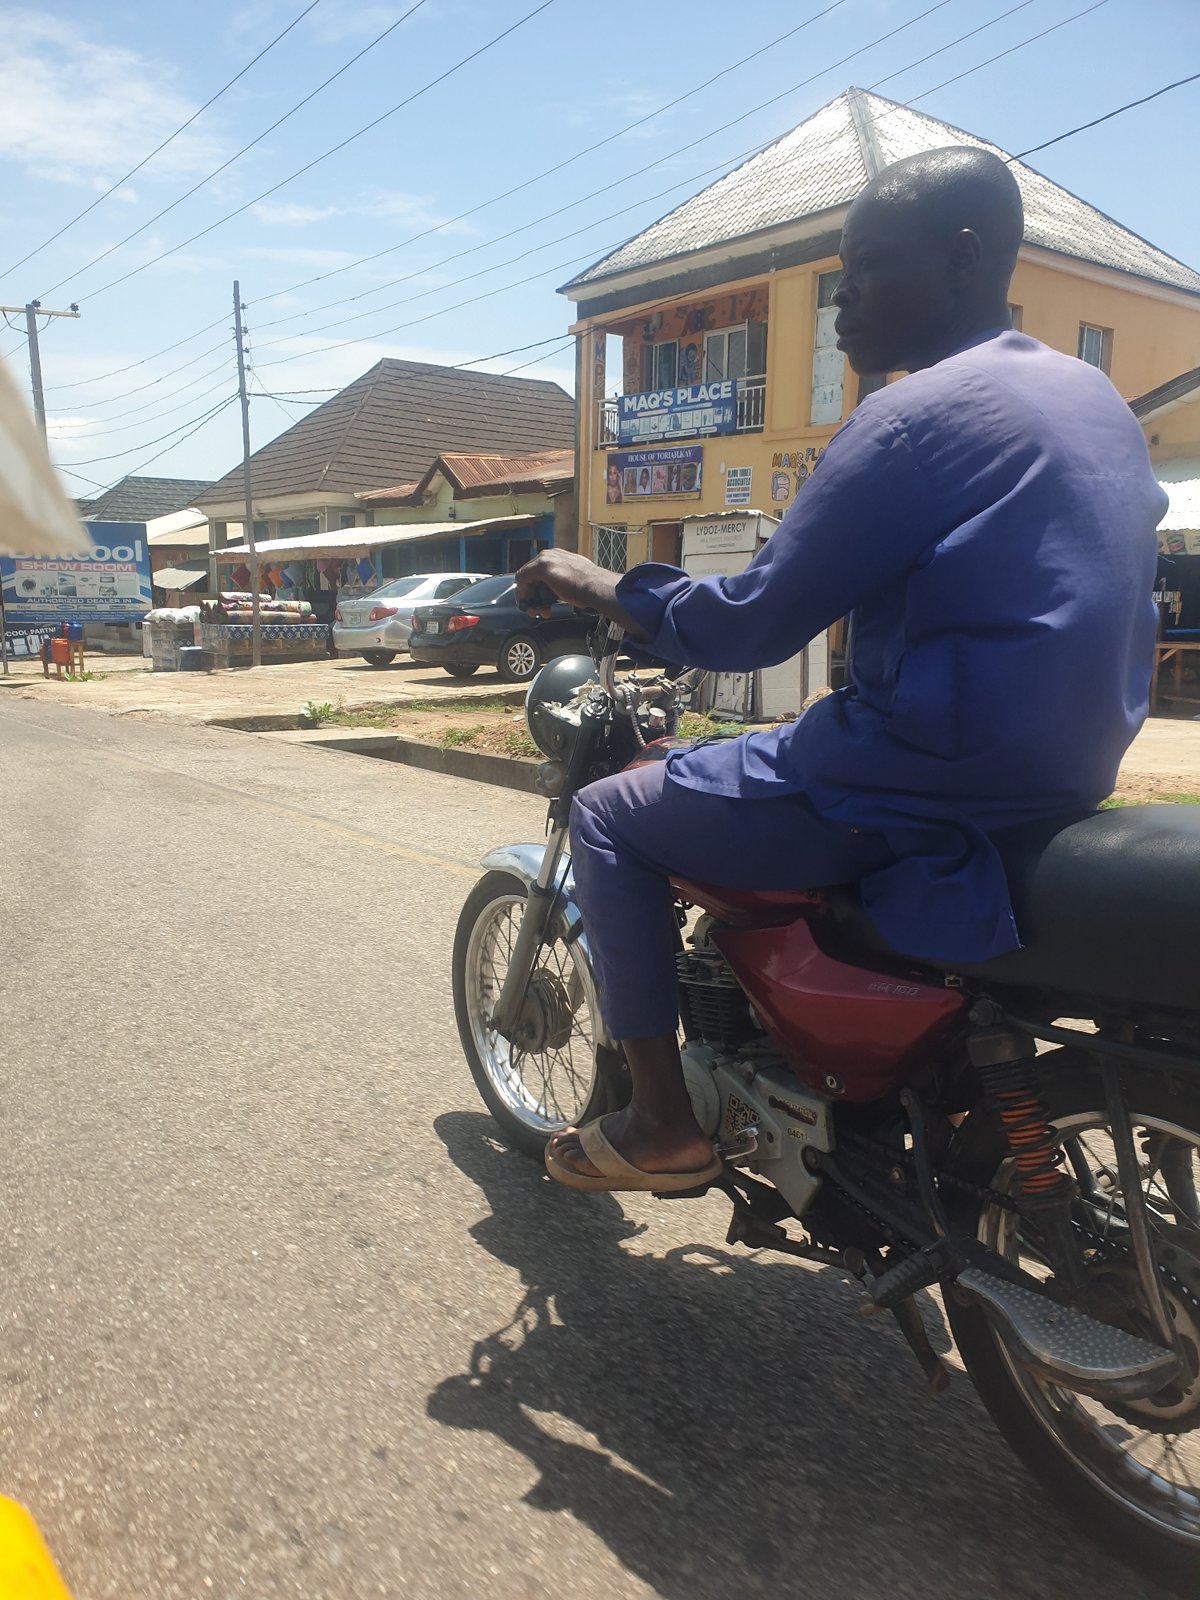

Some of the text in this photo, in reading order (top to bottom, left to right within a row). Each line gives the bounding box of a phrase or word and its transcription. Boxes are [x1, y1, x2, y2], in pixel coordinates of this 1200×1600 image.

[624, 391, 674, 413] MAQ'S
[677, 381, 732, 405] PLACE
[627, 453, 648, 463] HOUSE
[648, 452, 655, 461] OF
[696, 522, 746, 536] LYDOZ-MERCY
[21, 561, 132, 572] SHOW ROOM
